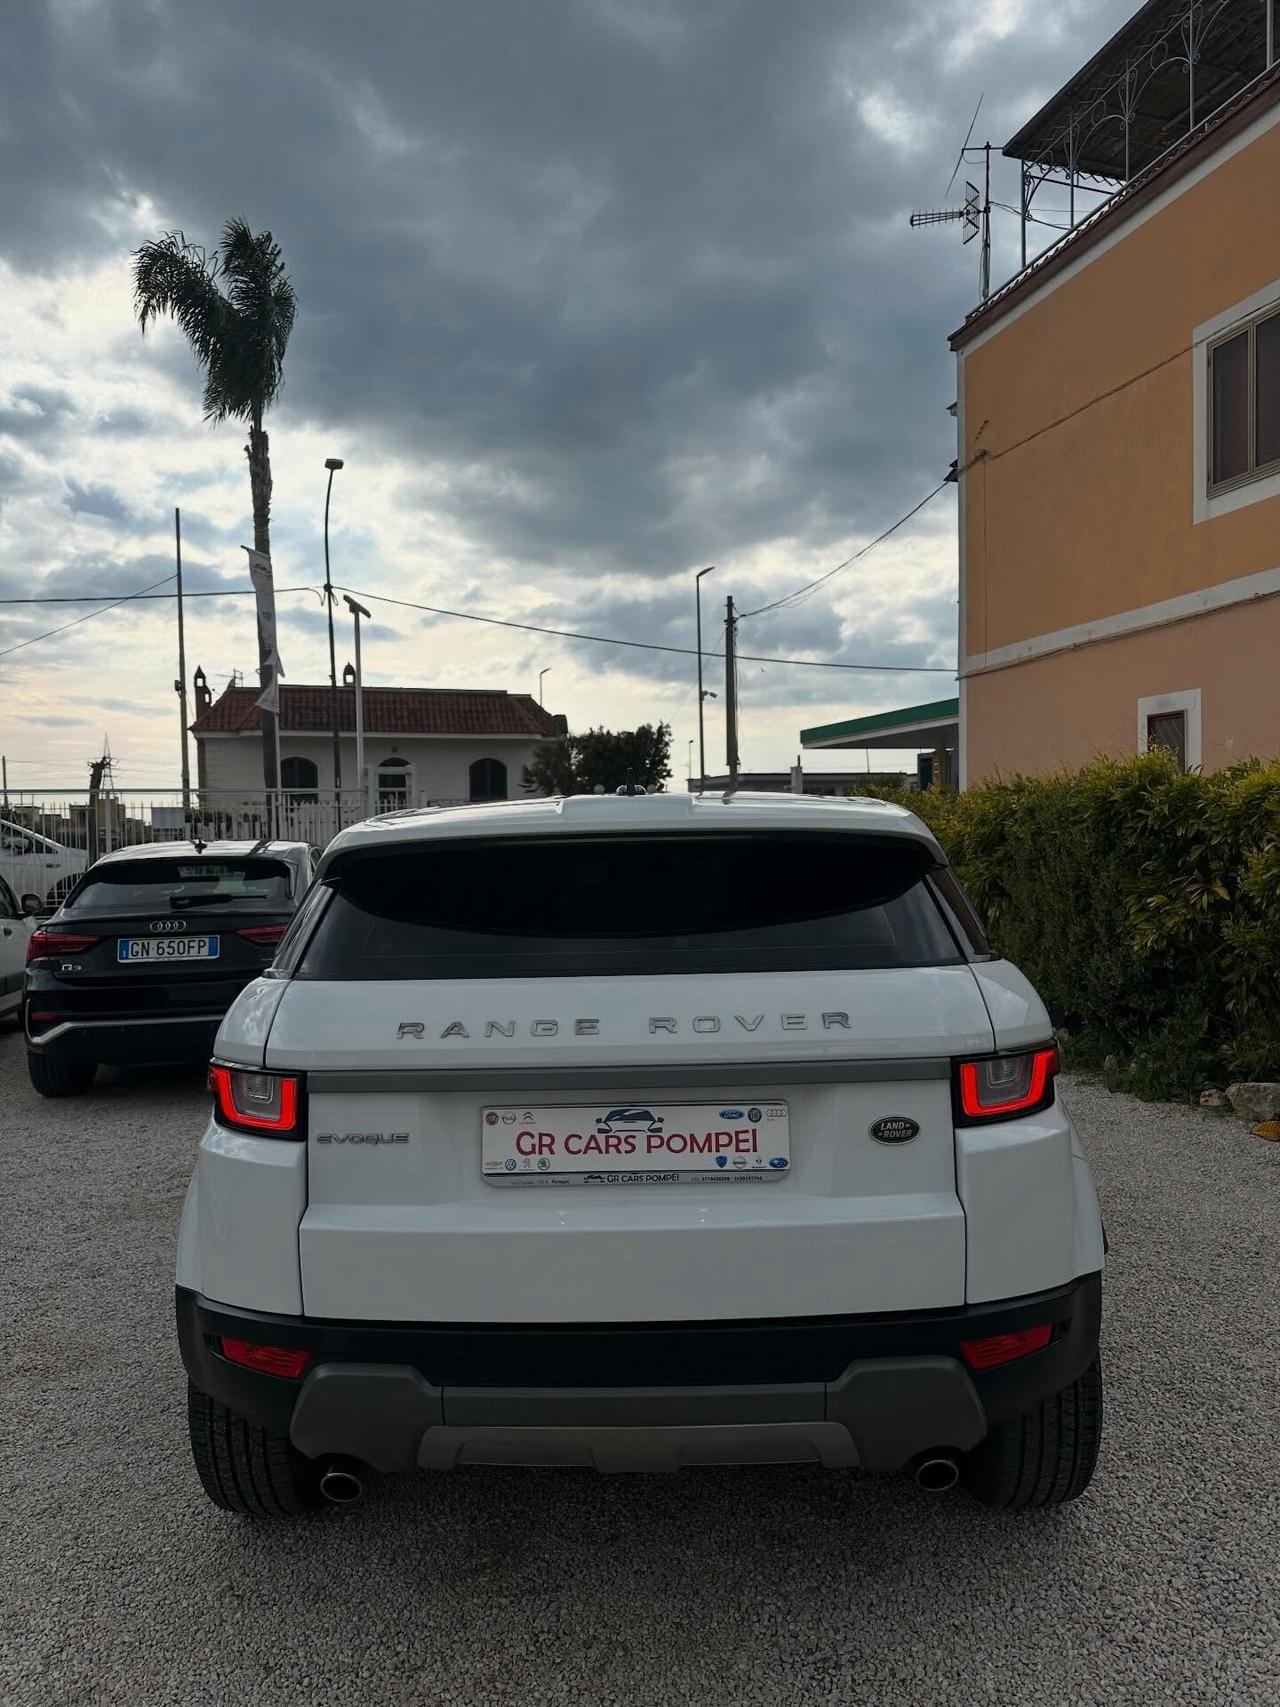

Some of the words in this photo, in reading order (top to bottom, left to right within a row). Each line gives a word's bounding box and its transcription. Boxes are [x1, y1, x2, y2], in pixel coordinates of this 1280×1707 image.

[130, 941, 150, 957] GN
[156, 939, 207, 956] 650FP
[397, 1018, 600, 1040] RANGE
[649, 1011, 853, 1035] ROVER
[880, 1121, 905, 1130] LAND
[317, 1133, 410, 1145] EVOQUE
[883, 1129, 912, 1138] ROVER
[515, 1131, 556, 1156] GR
[564, 1133, 637, 1155] CARS
[646, 1128, 758, 1154] POMPEI
[607, 1174, 620, 1183] GR
[621, 1174, 644, 1183] CARS
[646, 1173, 680, 1182] POMPEI
